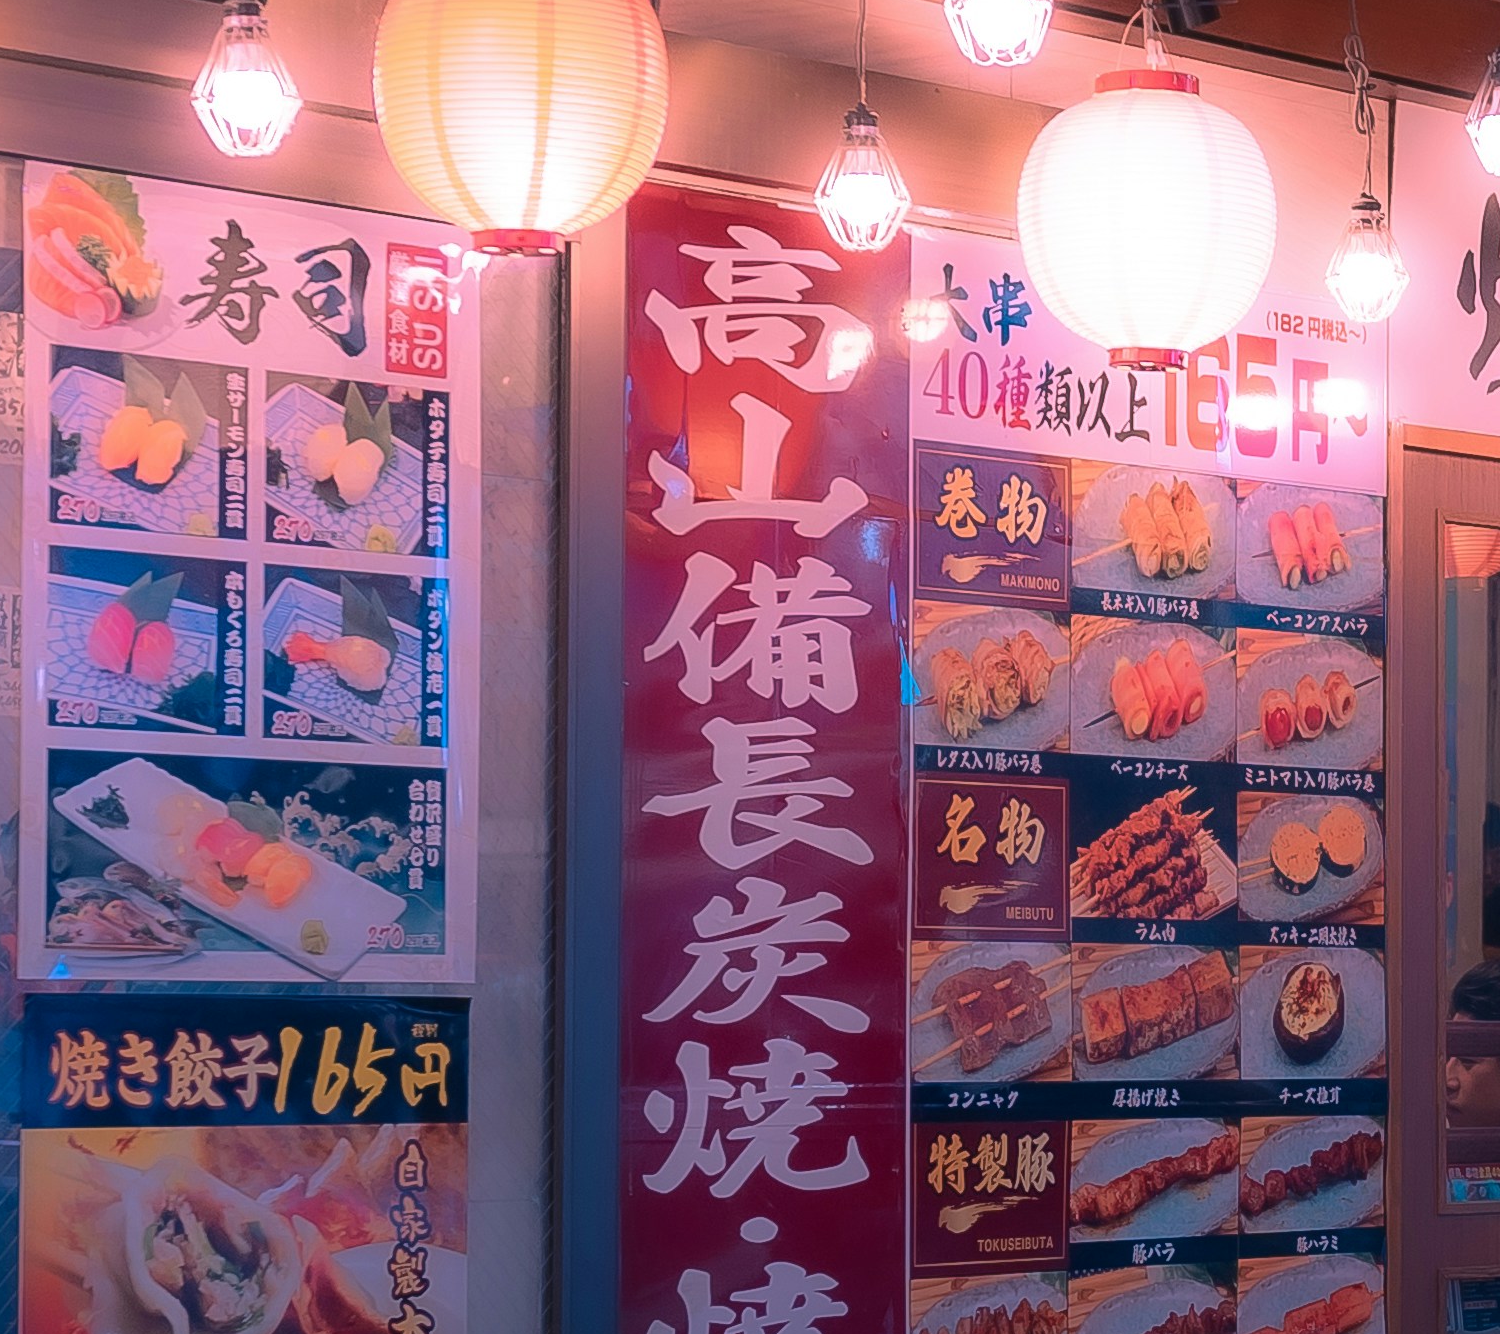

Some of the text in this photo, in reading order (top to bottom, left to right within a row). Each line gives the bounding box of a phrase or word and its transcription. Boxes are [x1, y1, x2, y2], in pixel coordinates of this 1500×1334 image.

[179, 219, 371, 357] 寿司
[927, 263, 1033, 346] 大串
[922, 347, 1150, 444] 40種類以上
[934, 465, 1048, 546] 巻物
[1001, 573, 1060, 593] MAKIMONO
[1266, 609, 1370, 636] ベーコンアスパラ
[1110, 761, 1189, 782] ベーコンチーズ
[936, 793, 1047, 865] 名物
[1005, 905, 1054, 922] MEIBUTU
[365, 923, 405, 950] 270
[1134, 922, 1177, 942] ラム肉
[47, 1023, 451, 1119] 焼き餃子 165円
[947, 1089, 1020, 1109] コンニャク
[1111, 1087, 1181, 1108] 厚揚げ焼き
[927, 1132, 1056, 1194] 特製豚
[977, 1236, 1053, 1253] TOKUSEIBUTA
[1131, 1242, 1176, 1264] 豚バラ
[1296, 1233, 1339, 1254] 豚ハラミ
